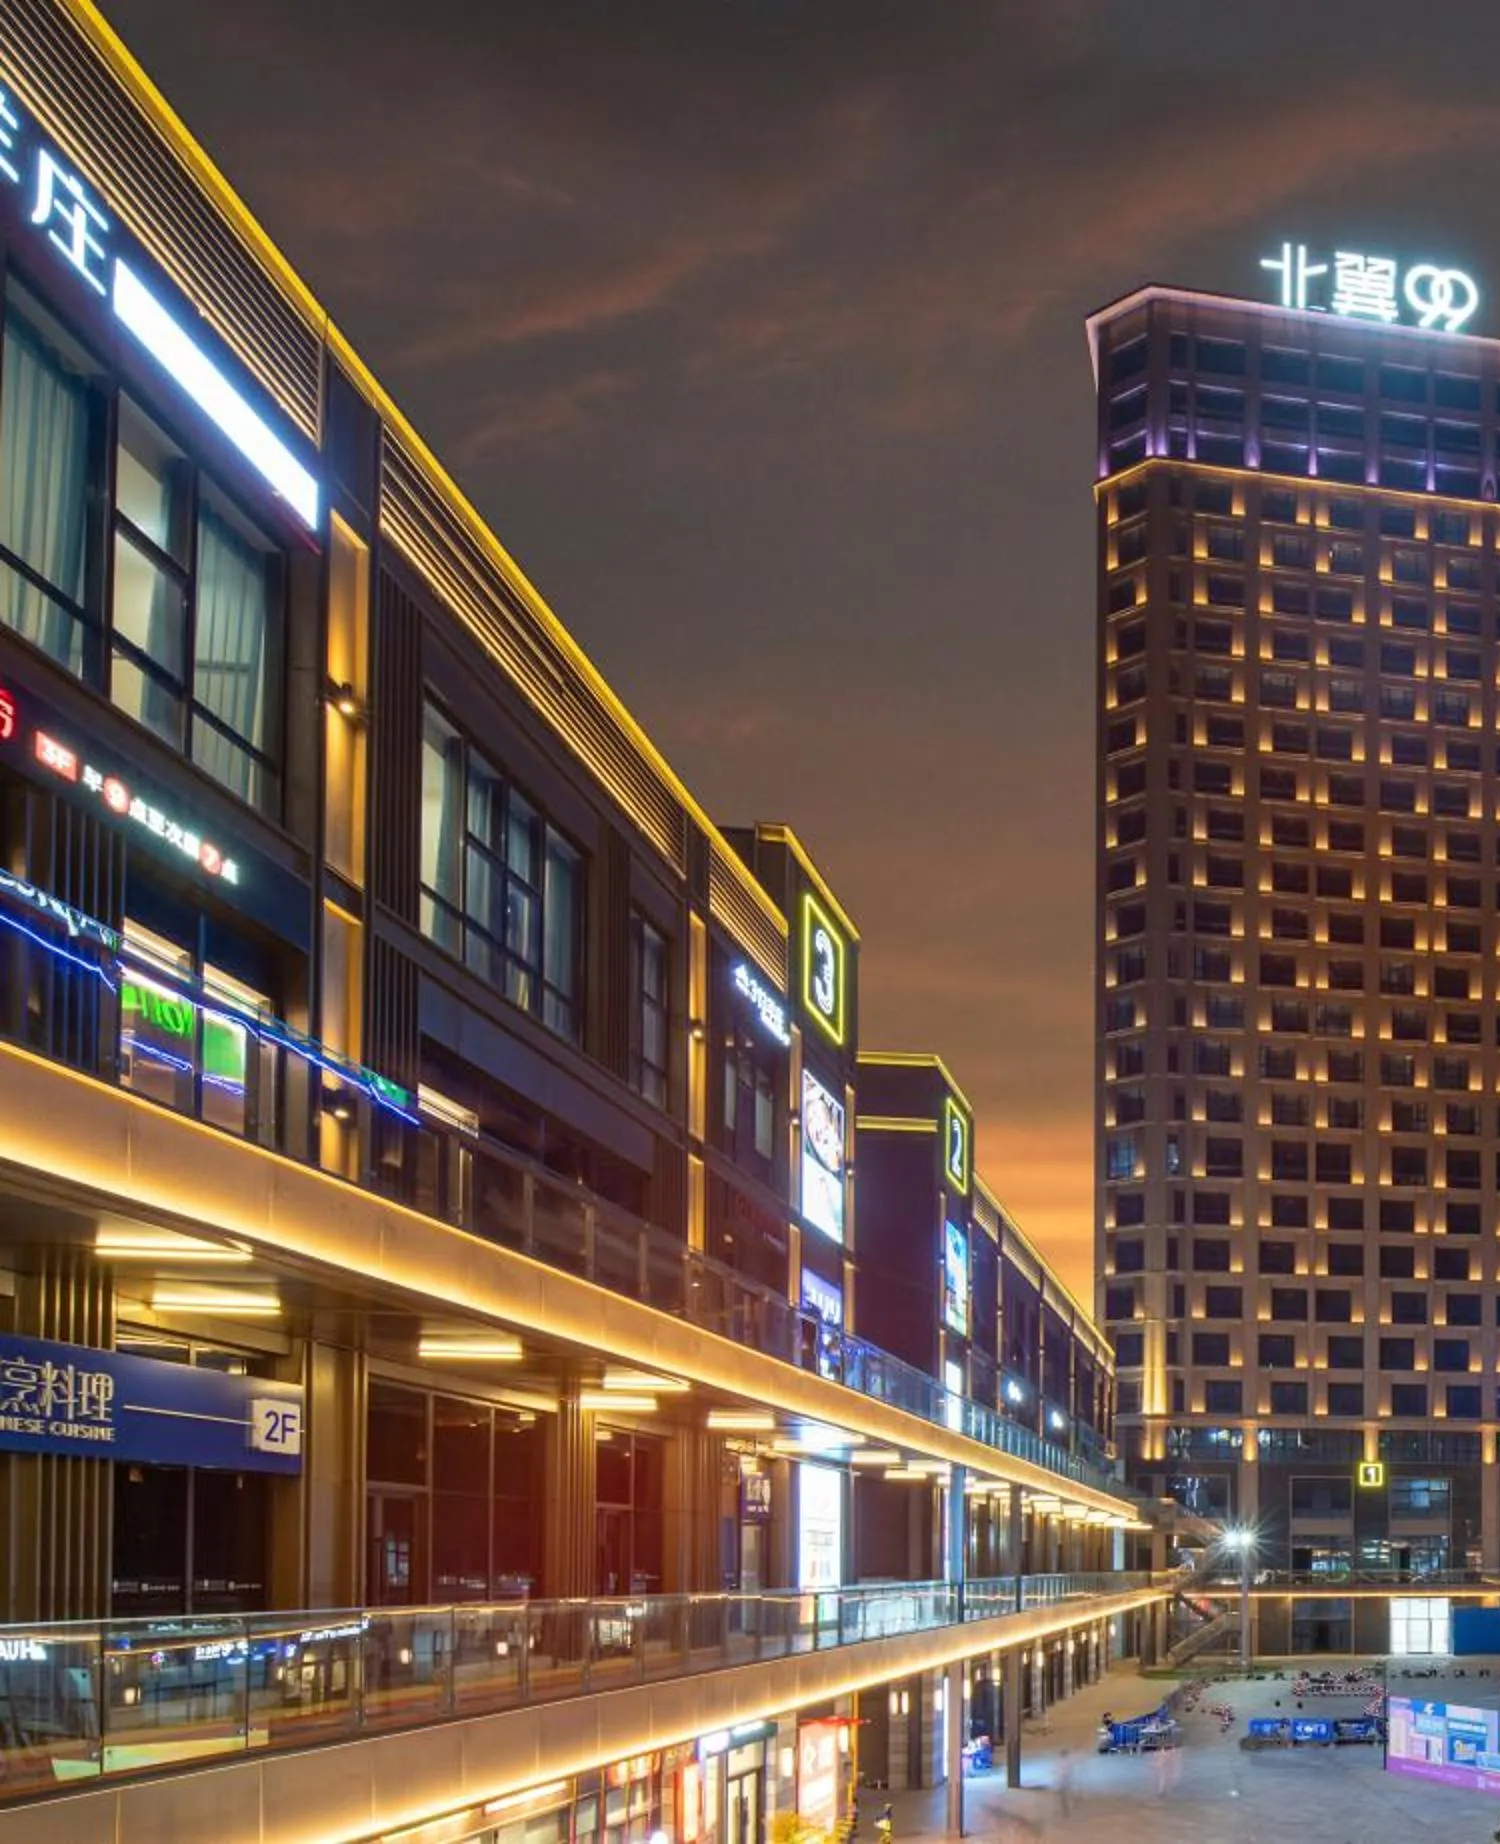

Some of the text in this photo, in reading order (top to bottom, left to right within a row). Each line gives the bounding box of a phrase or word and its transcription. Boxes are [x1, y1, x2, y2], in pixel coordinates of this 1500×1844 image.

[815, 928, 835, 1015] 3
[952, 1119, 962, 1180] 2
[50, 1421, 115, 1442] CUISINE
[264, 1411, 297, 1444] 2F
